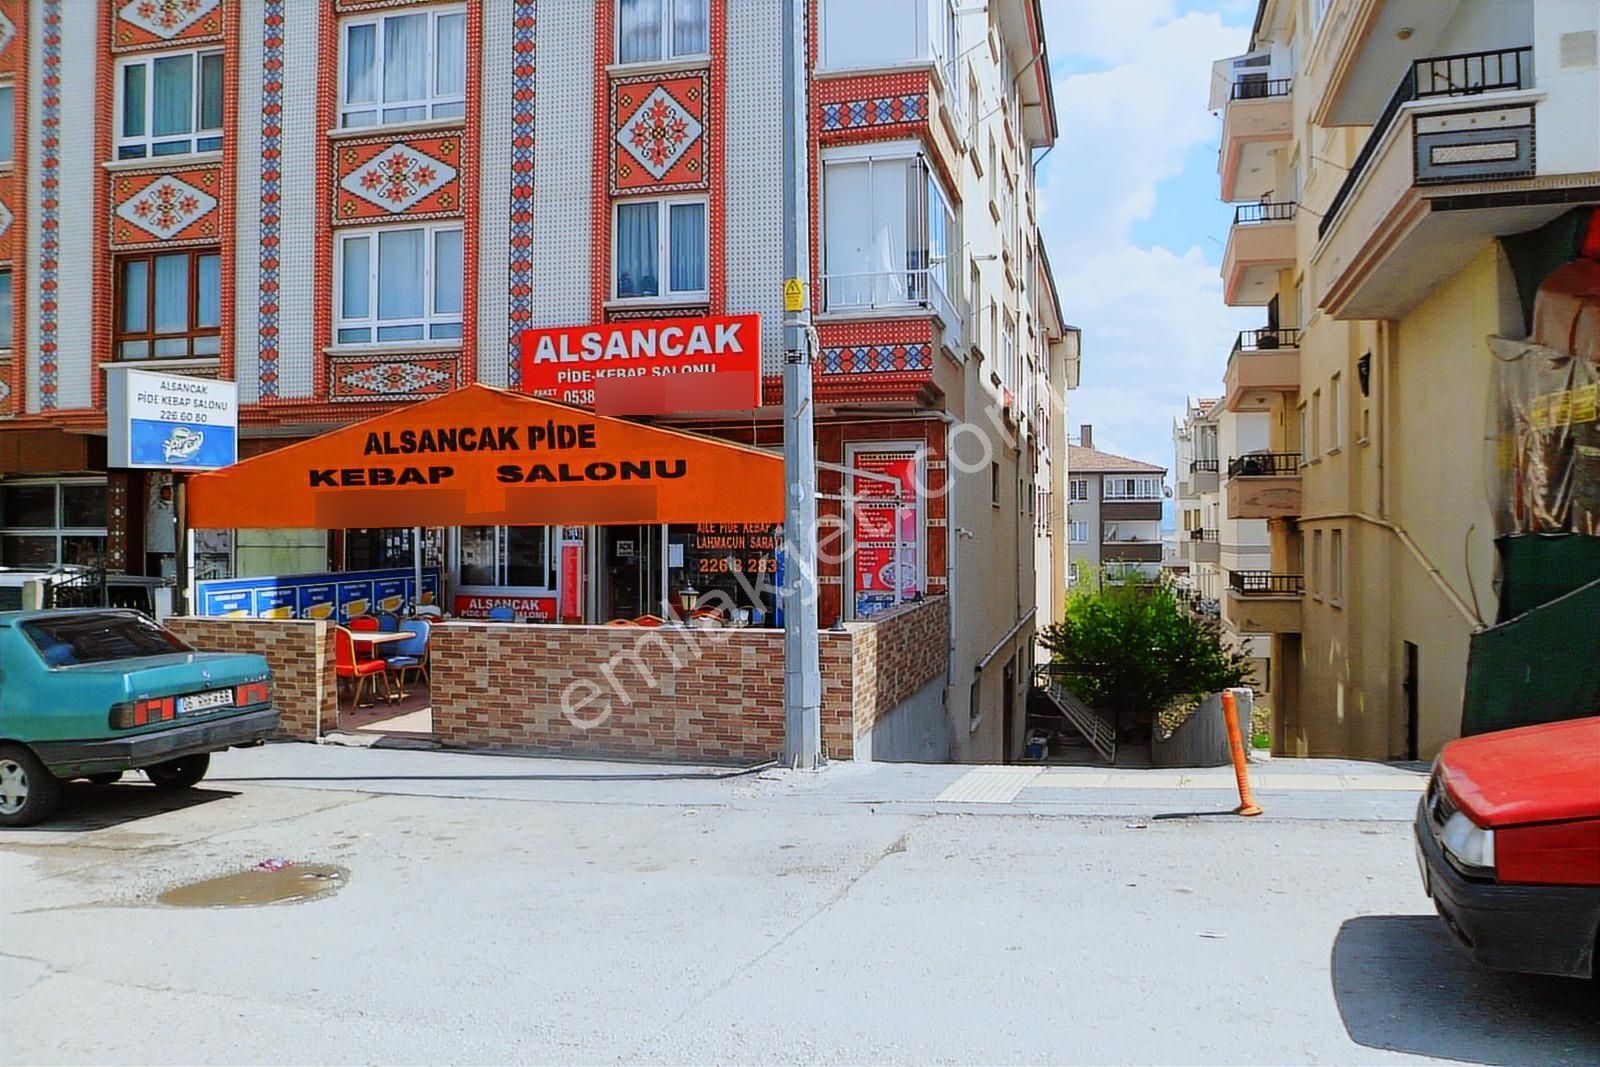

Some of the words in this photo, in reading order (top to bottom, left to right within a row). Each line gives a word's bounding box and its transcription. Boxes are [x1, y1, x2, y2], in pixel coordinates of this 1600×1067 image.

[533, 323, 743, 364] ALSANCAK
[160, 381, 208, 394] ALSANCAK
[137, 391, 161, 404] PİDE
[161, 395, 191, 406] KEBAP
[193, 399, 228, 411] SALONU
[363, 426, 518, 456] ALSANCAK
[528, 419, 596, 450] PİDE
[309, 466, 454, 487] KEBAP
[496, 459, 687, 484] SALONU
[696, 536, 745, 549] LAHMACUN
[699, 559, 728, 573] 226
[469, 598, 540, 610] ALSANCAK
